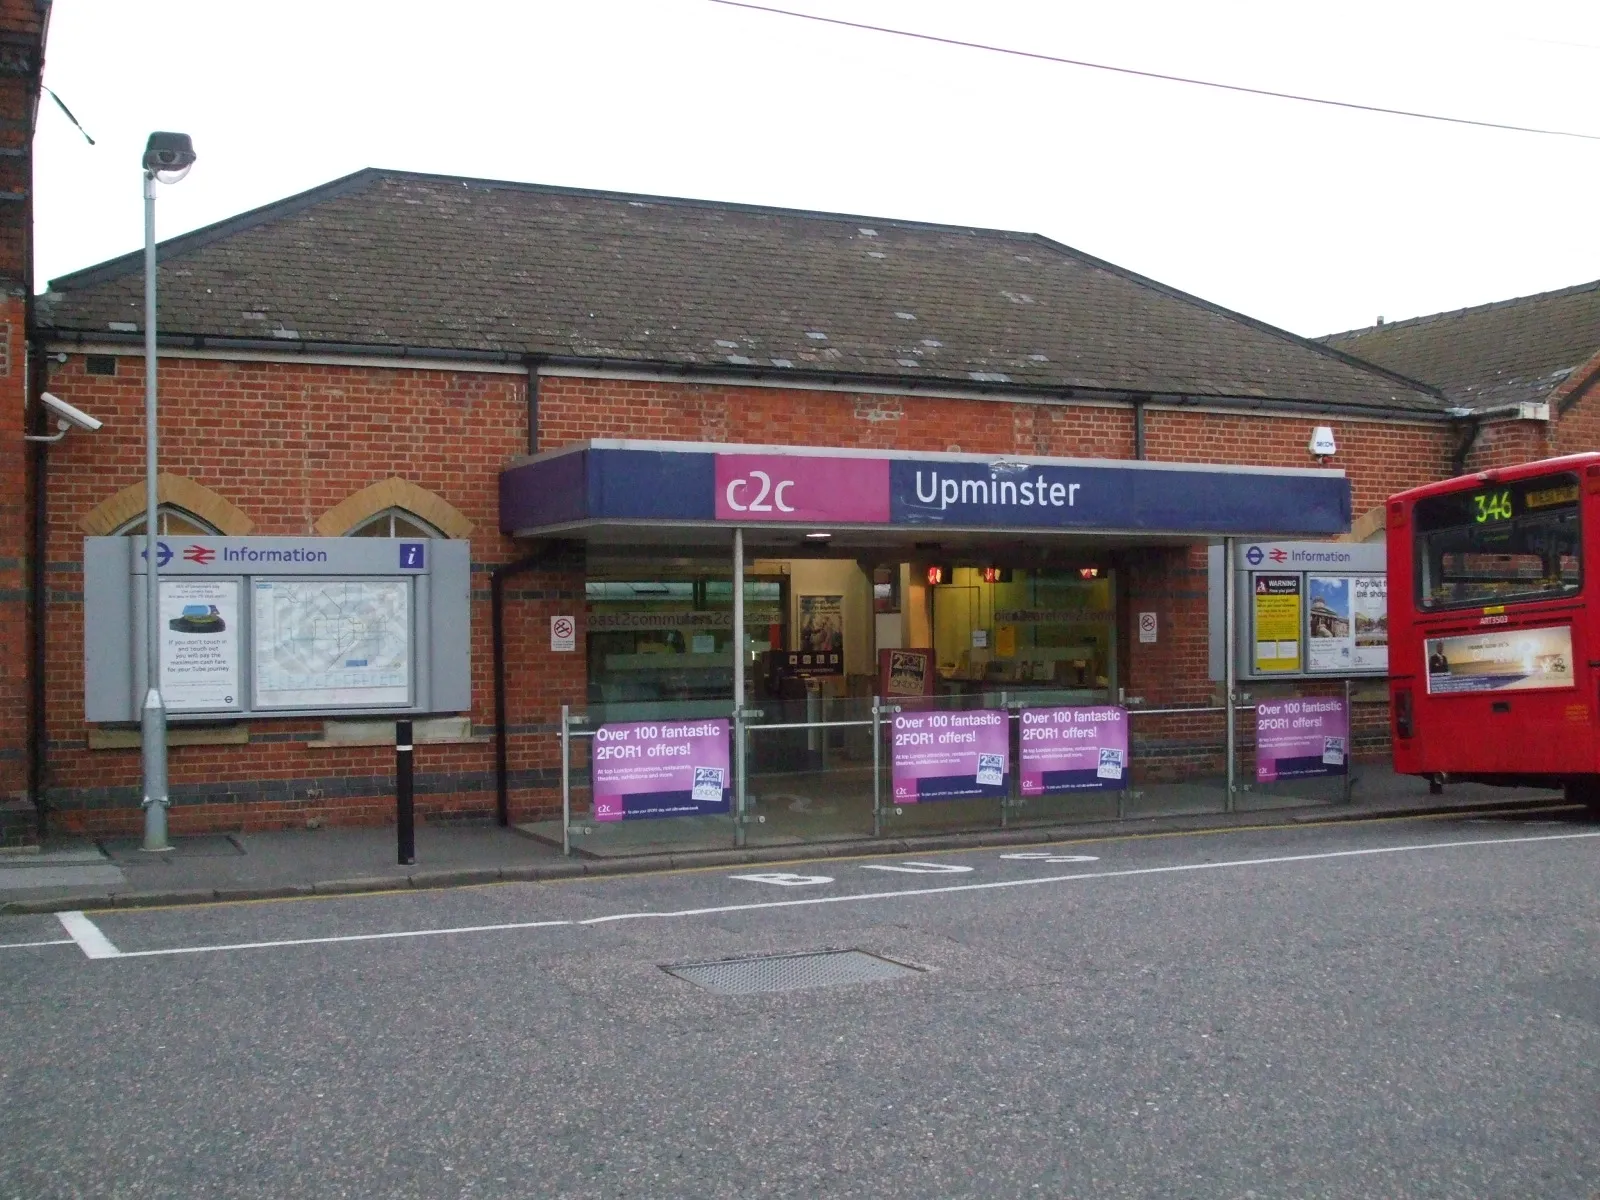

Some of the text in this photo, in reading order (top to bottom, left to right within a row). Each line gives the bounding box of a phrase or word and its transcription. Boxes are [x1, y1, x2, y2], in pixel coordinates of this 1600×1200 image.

[726, 470, 795, 512] c2c
[916, 470, 1081, 510] Upminster
[1474, 490, 1512, 523] 346
[223, 546, 328, 564] Information
[1292, 550, 1350, 562] Information
[1355, 580, 1369, 588] Pop
[1258, 701, 1342, 715] Over 100 fantastic
[896, 713, 1001, 729] Over 100 fantastic
[1023, 709, 1120, 724] Over 100 fantastic
[1258, 717, 1323, 730] 2FOR1 offers!
[597, 724, 720, 741] Over 100 fantastic
[896, 731, 976, 746] 2FOR1 offers!
[1023, 726, 1097, 740] 2FOR1 offers!
[597, 742, 692, 759] 2FOR1 offers!
[729, 852, 1100, 886] BUS
